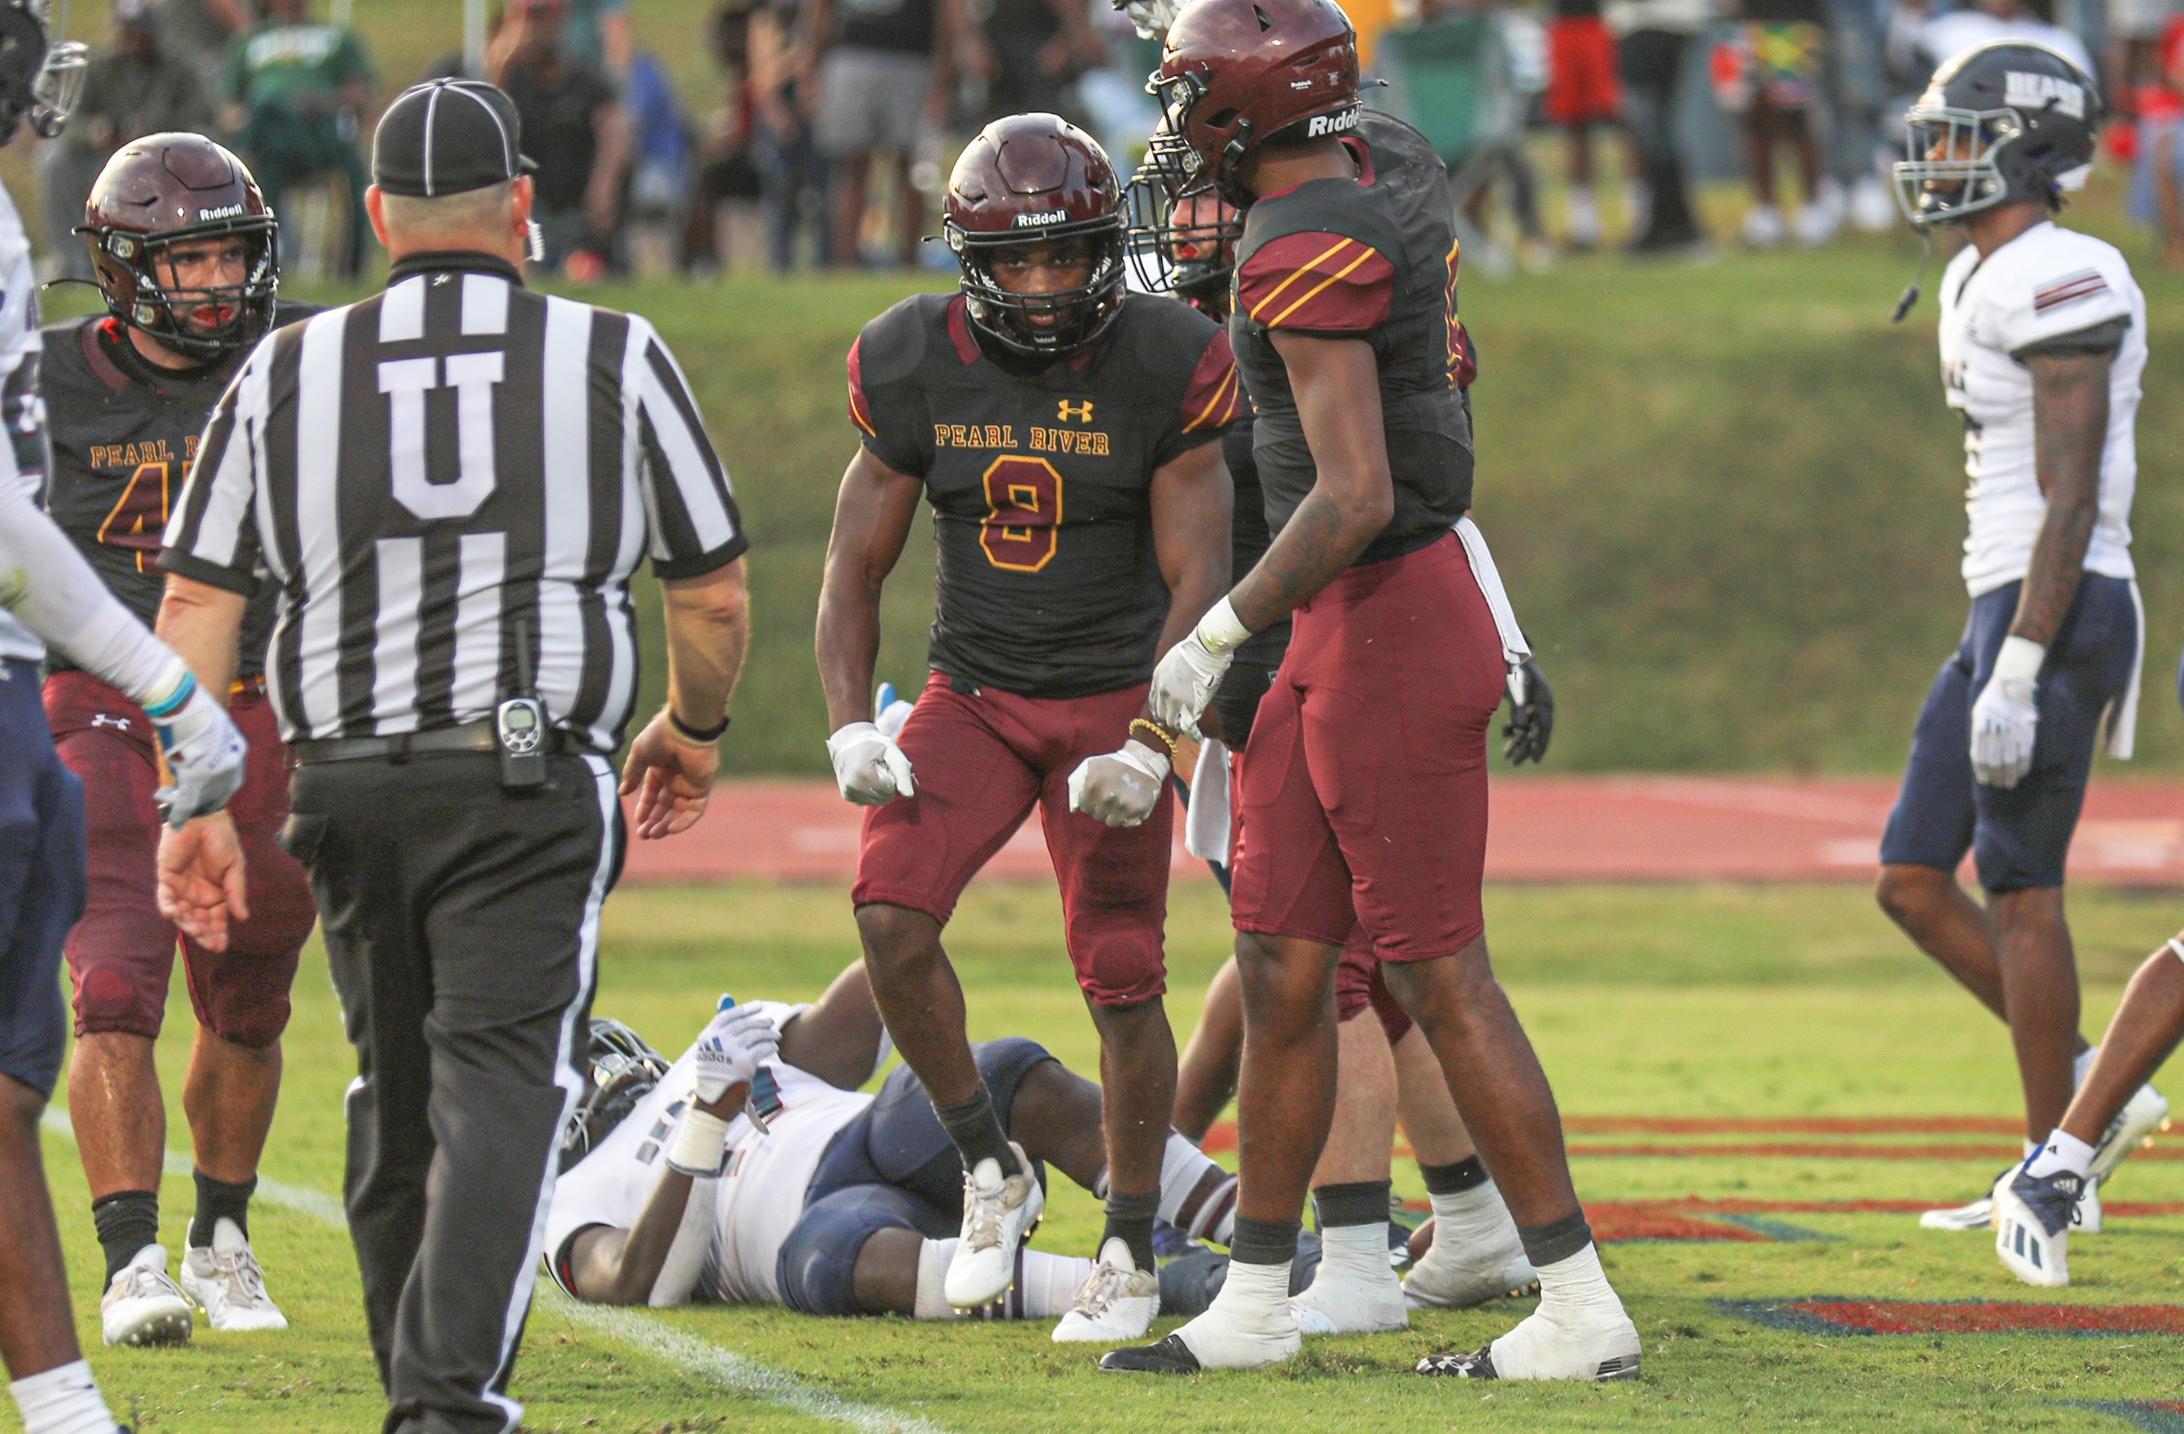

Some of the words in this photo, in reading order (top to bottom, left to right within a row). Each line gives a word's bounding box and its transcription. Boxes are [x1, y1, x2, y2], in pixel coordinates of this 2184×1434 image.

[199, 203, 243, 221] Riddell
[1017, 209, 1067, 227] Riddell
[377, 350, 505, 521] U
[934, 424, 1018, 449] PEARL
[1029, 427, 1110, 455] RIVER
[90, 439, 175, 470] PEARL
[97, 461, 193, 574] 4
[979, 454, 1063, 573] 8
